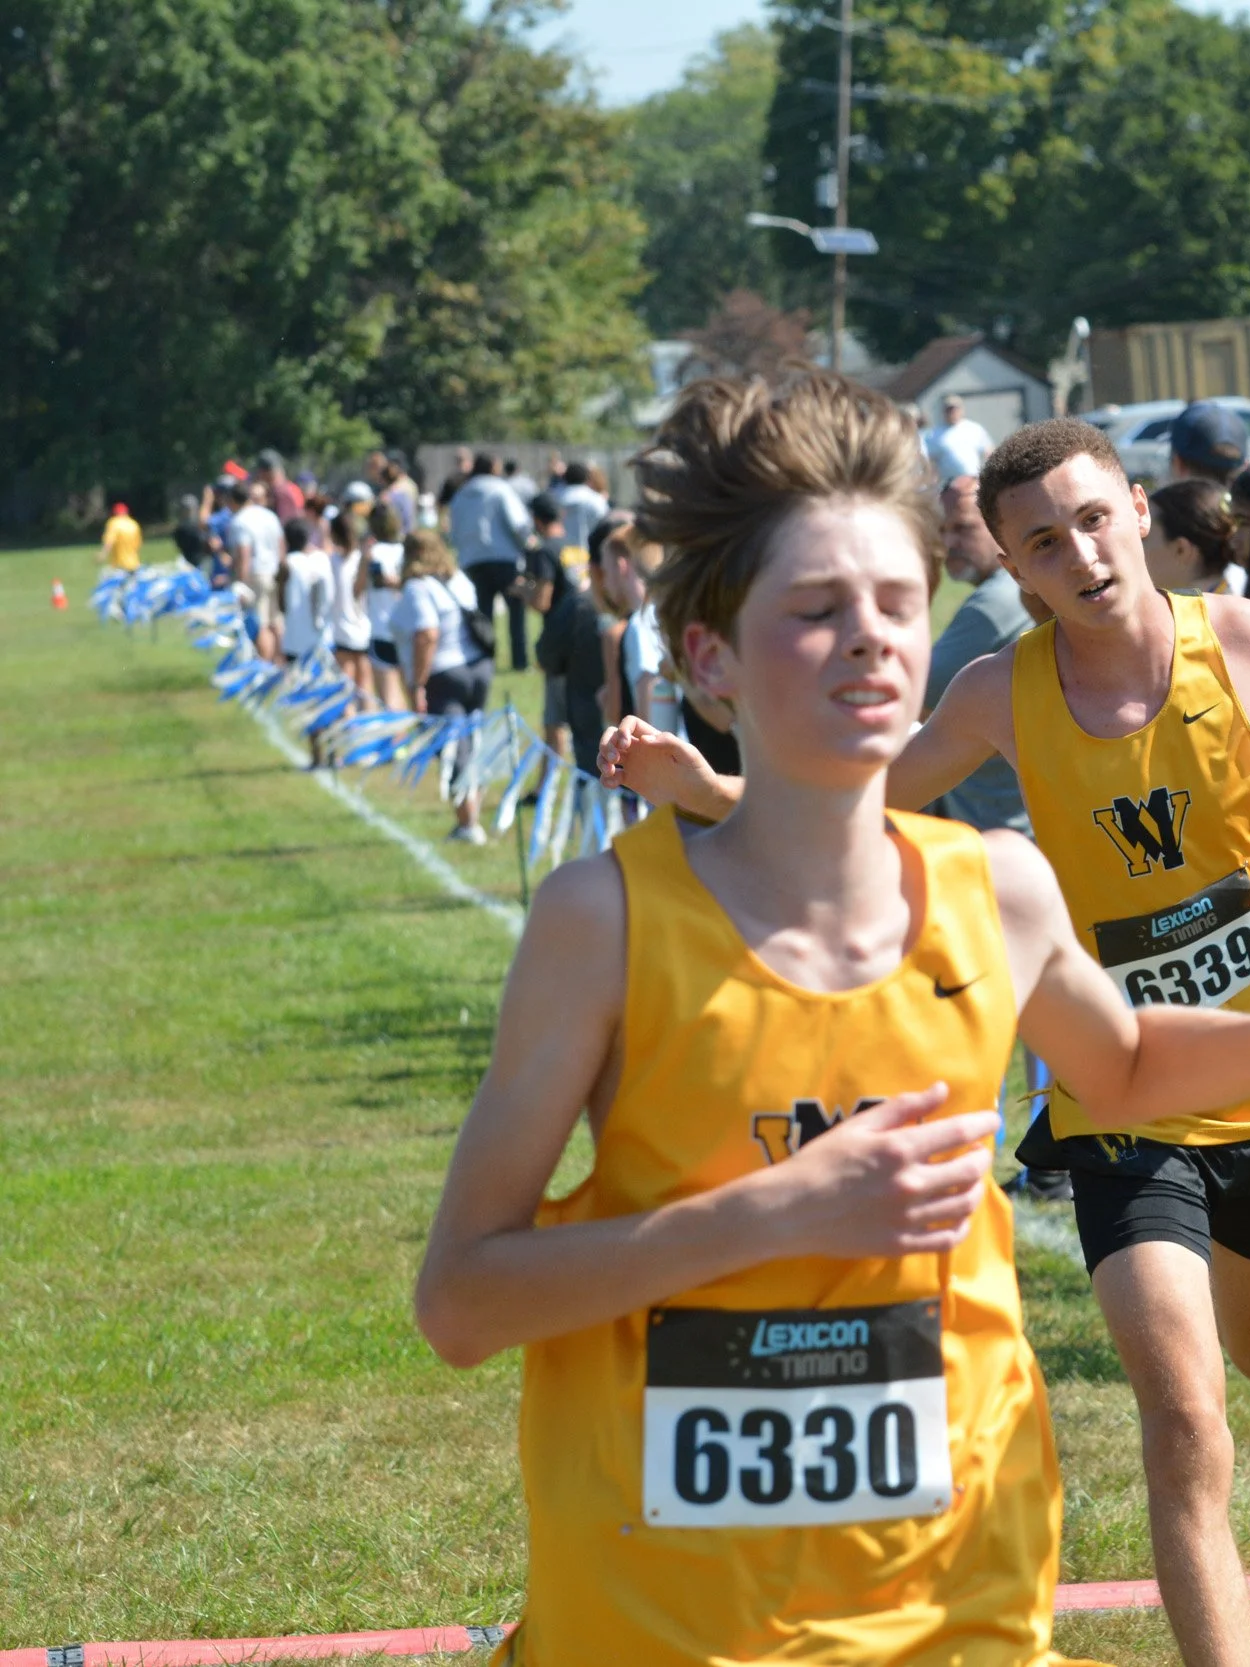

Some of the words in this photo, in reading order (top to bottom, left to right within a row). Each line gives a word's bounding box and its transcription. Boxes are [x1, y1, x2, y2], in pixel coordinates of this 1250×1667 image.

[1151, 897, 1214, 938] LEXICON
[1165, 911, 1218, 944] TIMING
[751, 1319, 870, 1357] LEXICON
[770, 1349, 869, 1380] TIMING
[674, 1402, 918, 1507] 6330
